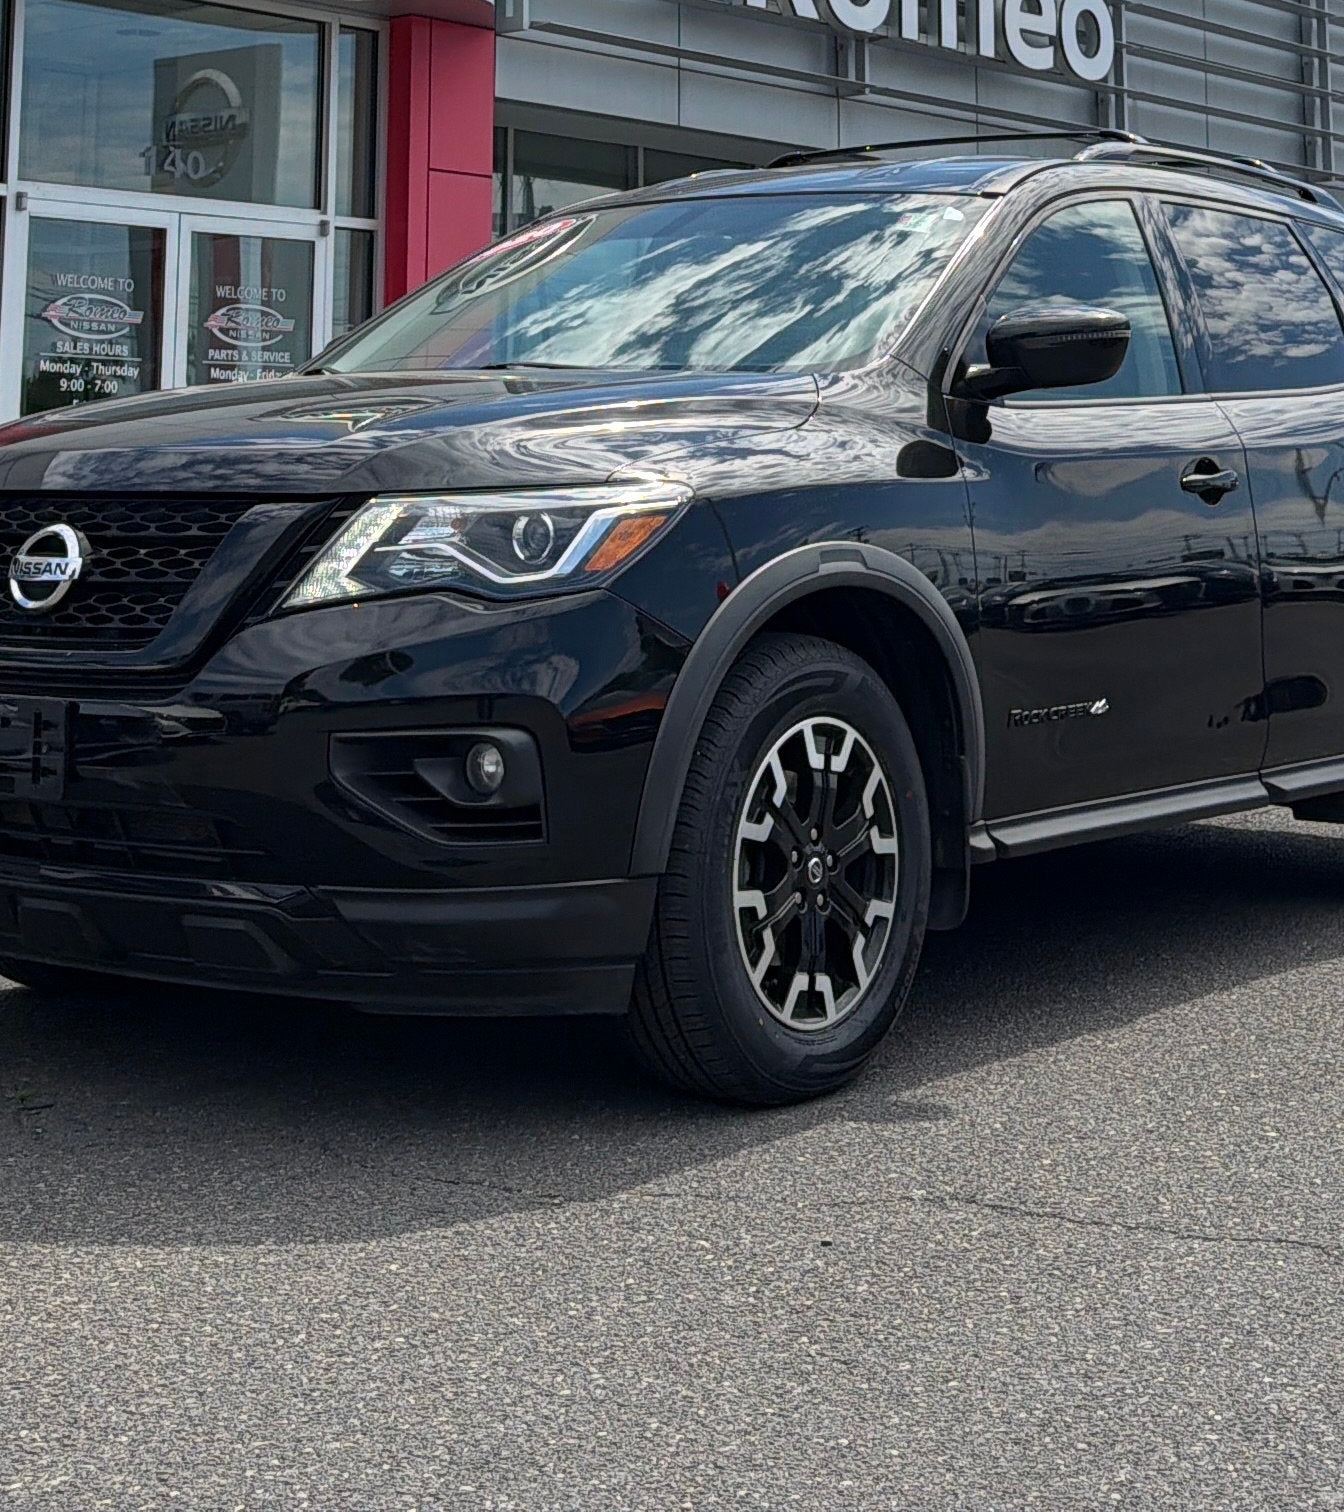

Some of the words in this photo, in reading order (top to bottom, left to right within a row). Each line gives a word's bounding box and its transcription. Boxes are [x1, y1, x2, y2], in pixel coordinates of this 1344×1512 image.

[56, 273, 115, 291] WELCOME
[117, 277, 135, 292] TO
[216, 284, 270, 301] WELCOME
[271, 288, 287, 302] TO
[59, 296, 128, 321] Romeo
[70, 320, 116, 332] NISSAN
[221, 306, 281, 329] Romeo
[229, 329, 271, 340] NISSAN
[56, 340, 90, 354] SALES
[92, 342, 129, 357] HOURS
[208, 349, 239, 361] PARTS
[241, 351, 248, 361] &
[250, 351, 291, 363] SERVICE
[40, 359, 83, 376] Monday
[91, 361, 140, 379] Thursday
[210, 367, 248, 383] Monday
[59, 378, 85, 392] 9:00
[94, 379, 118, 393] 7:00
[13, 557, 70, 577] NISSAN
